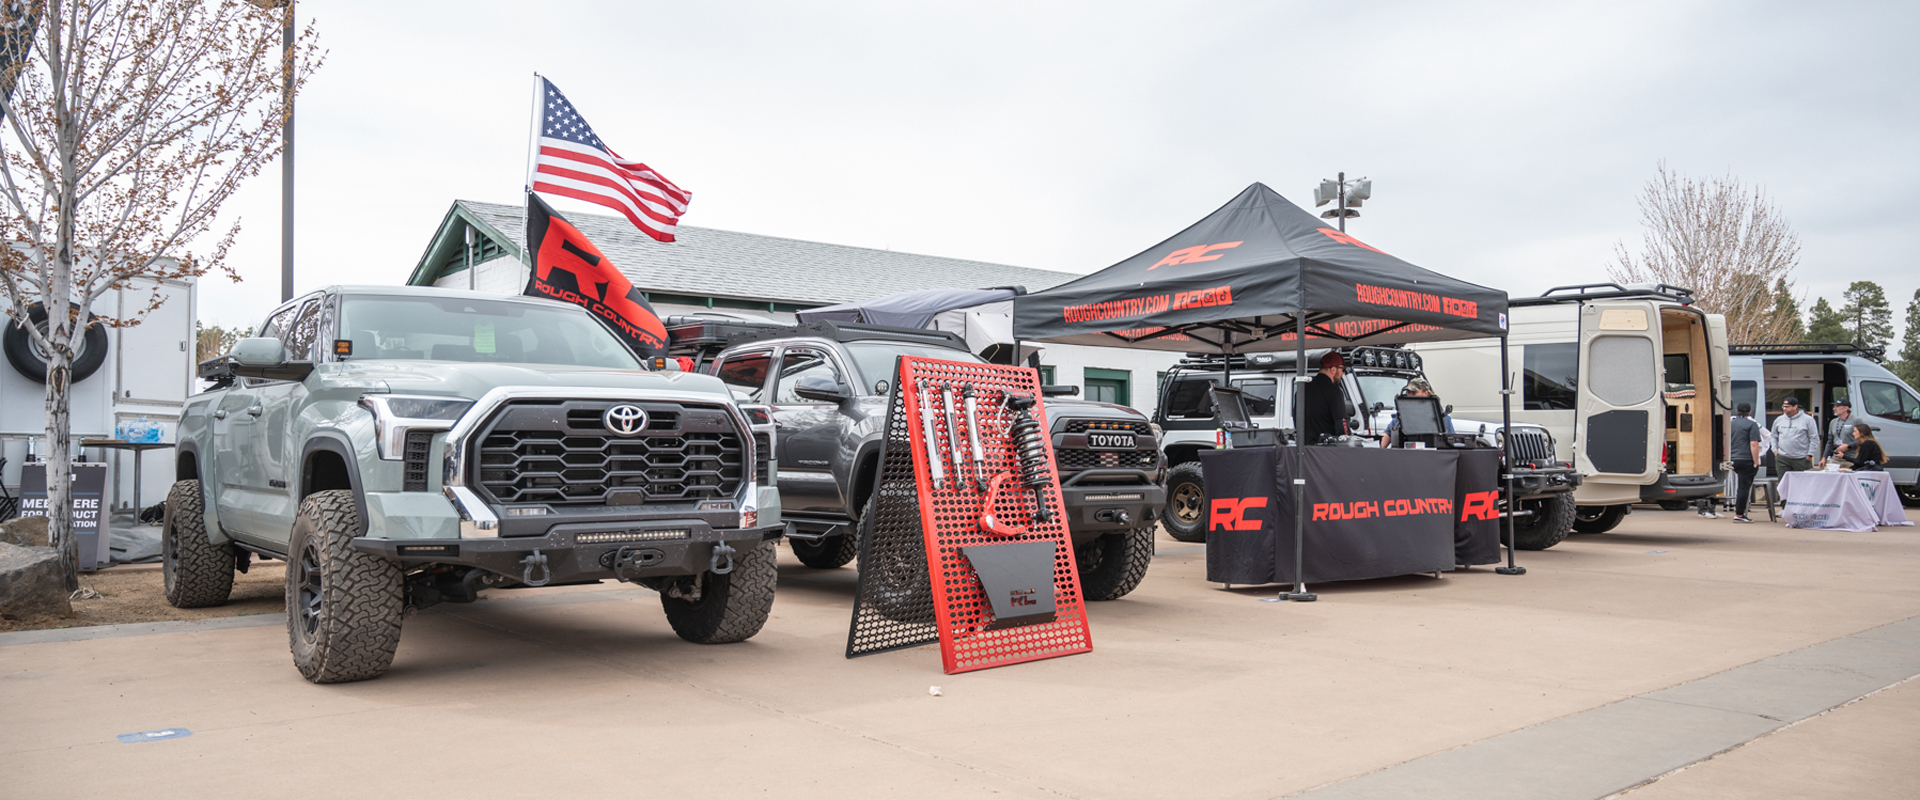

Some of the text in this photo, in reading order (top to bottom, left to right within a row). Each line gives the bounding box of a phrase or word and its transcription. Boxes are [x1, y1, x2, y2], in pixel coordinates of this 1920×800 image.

[1146, 240, 1244, 271] RC
[1063, 294, 1170, 323] ROUGHCOUNTRY.COM
[1355, 283, 1441, 313] ROUGHCOUNTRY.COM
[534, 279, 664, 350] ROUGH COUNTRY
[1091, 434, 1135, 447] TOYOTA
[22, 498, 99, 509] MEE ERE
[1208, 496, 1269, 532] RC
[1311, 497, 1453, 522] ROUGH COUNTRY
[1461, 489, 1500, 522] RC
